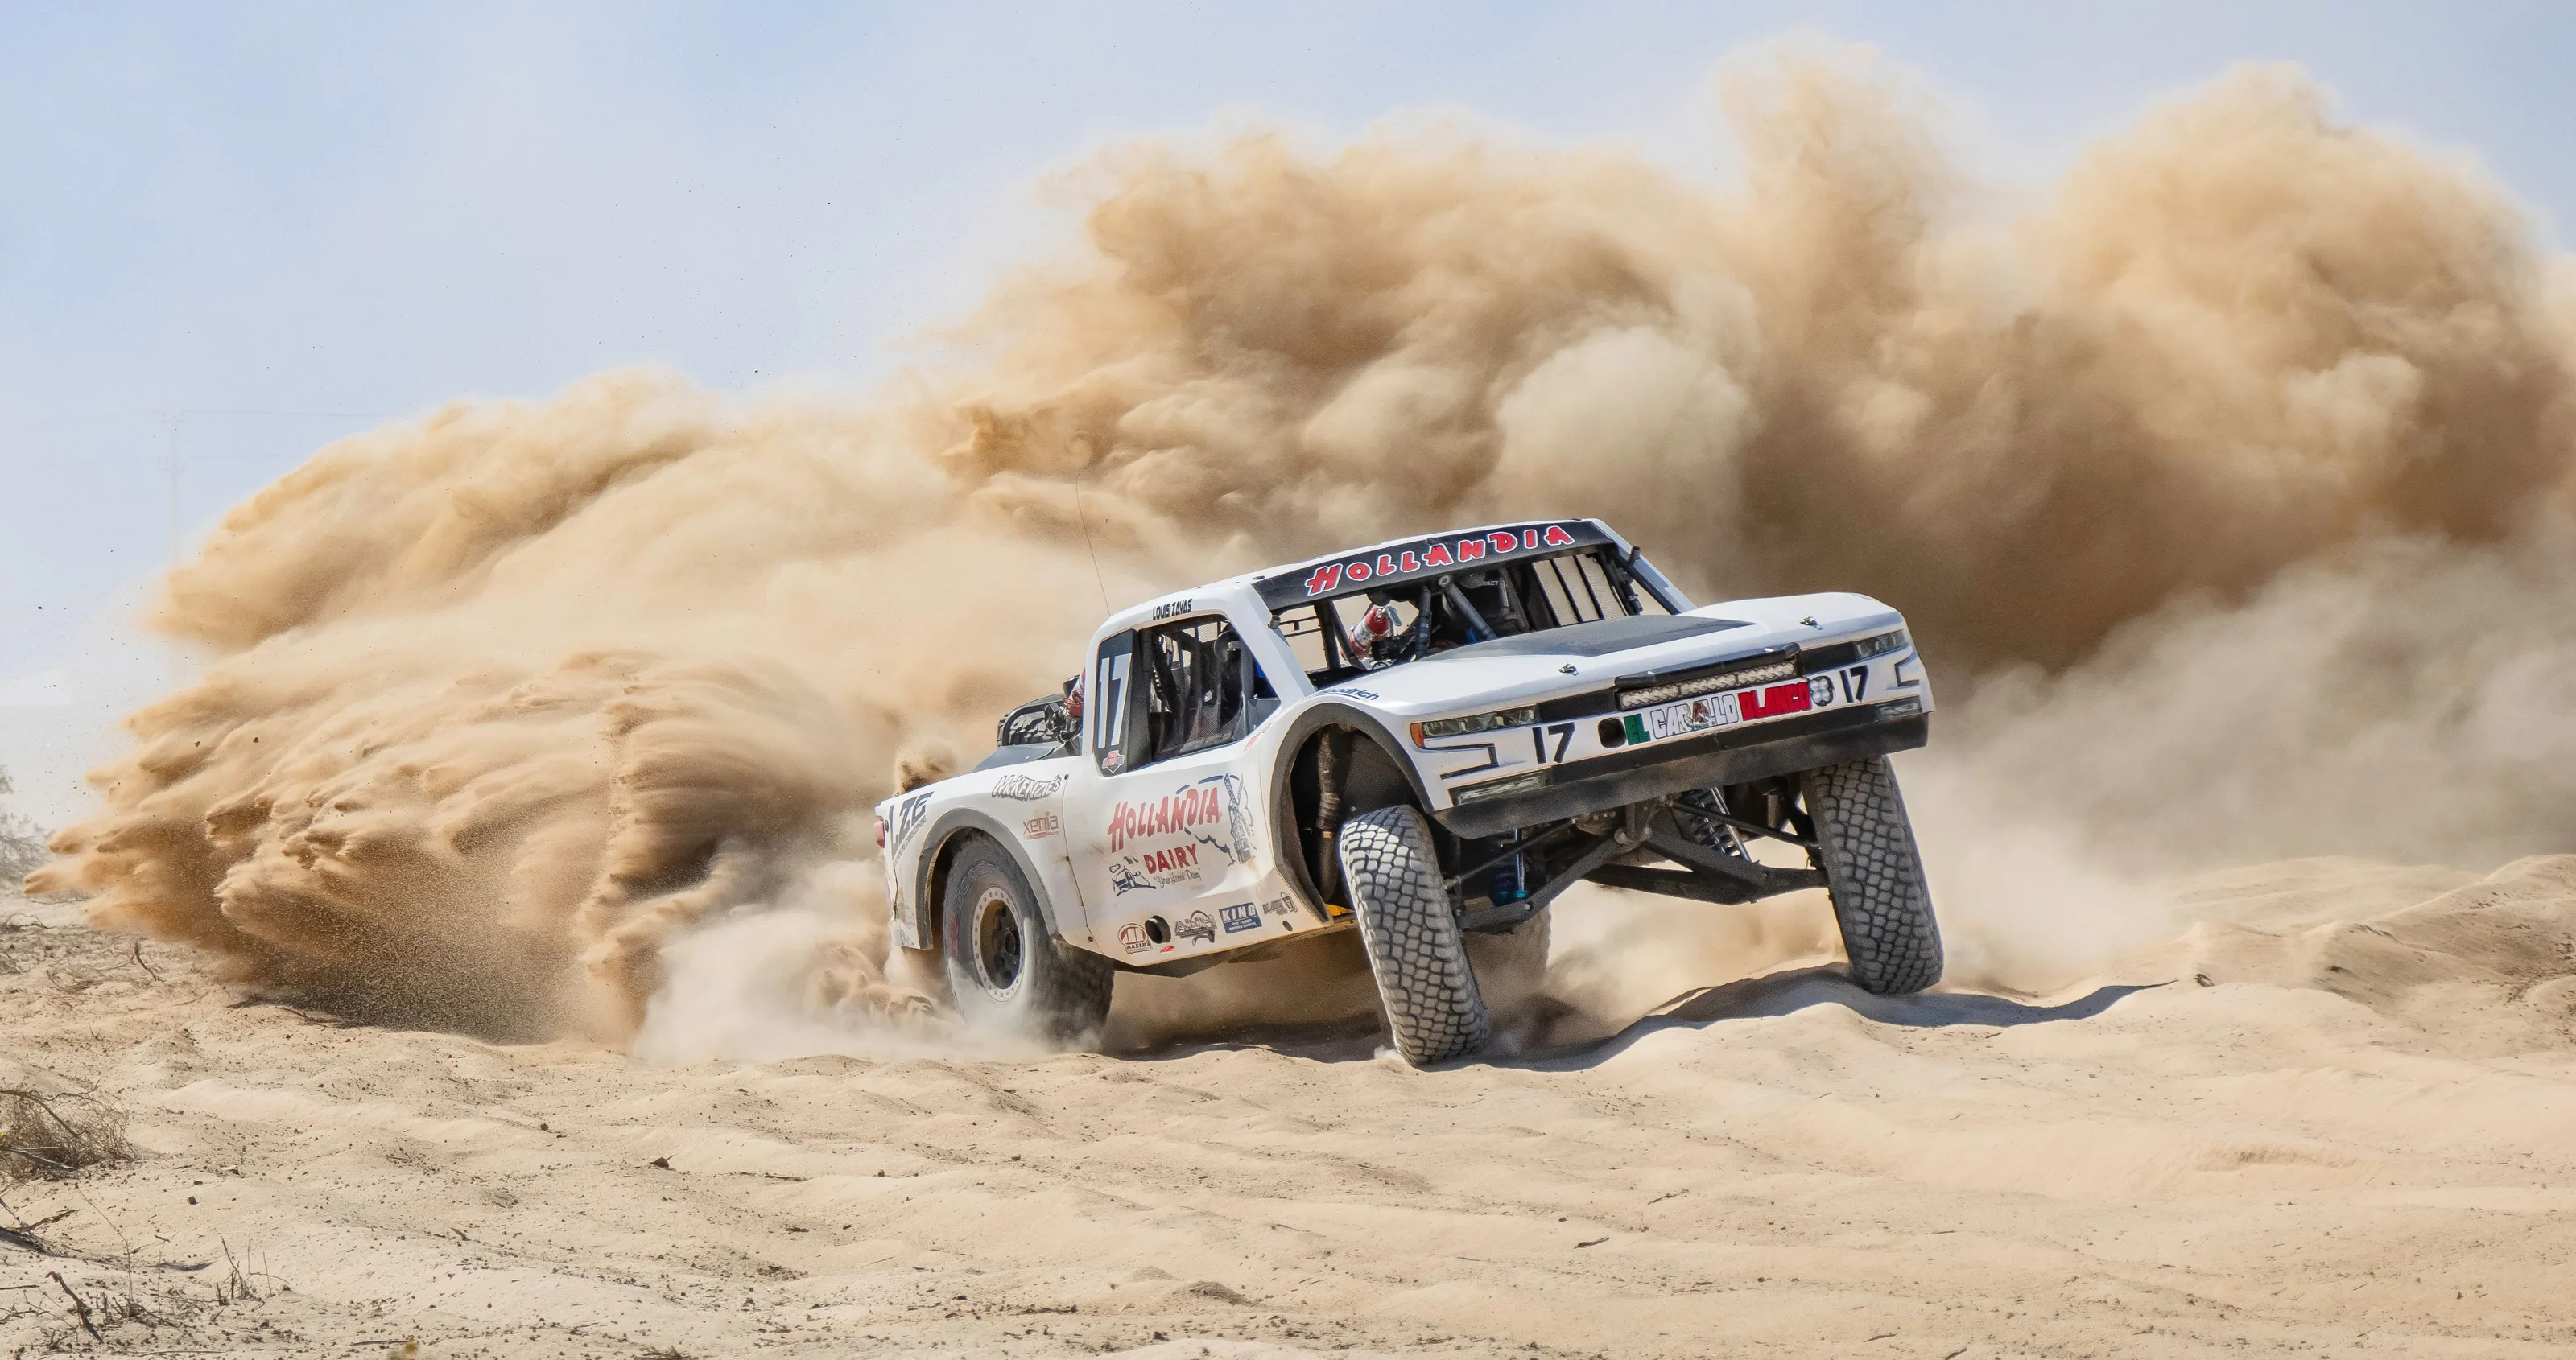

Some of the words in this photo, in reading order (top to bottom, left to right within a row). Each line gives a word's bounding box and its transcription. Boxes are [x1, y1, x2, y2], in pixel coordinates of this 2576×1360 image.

[1305, 525, 1575, 596] HOLLANDIA
[1153, 603, 1171, 620] LOUIS
[1097, 653, 1133, 749] 17
[1839, 665, 1869, 703] 17
[1623, 713, 1651, 746] EL
[1650, 694, 1739, 740] CABALLO
[1737, 682, 1812, 722] BLANCO
[1532, 721, 1575, 764] 17
[1022, 811, 1059, 835] xenia
[1108, 787, 1220, 854] HOLLANDIA
[1143, 843, 1199, 875] DAIRY
[1222, 904, 1256, 922] KING
